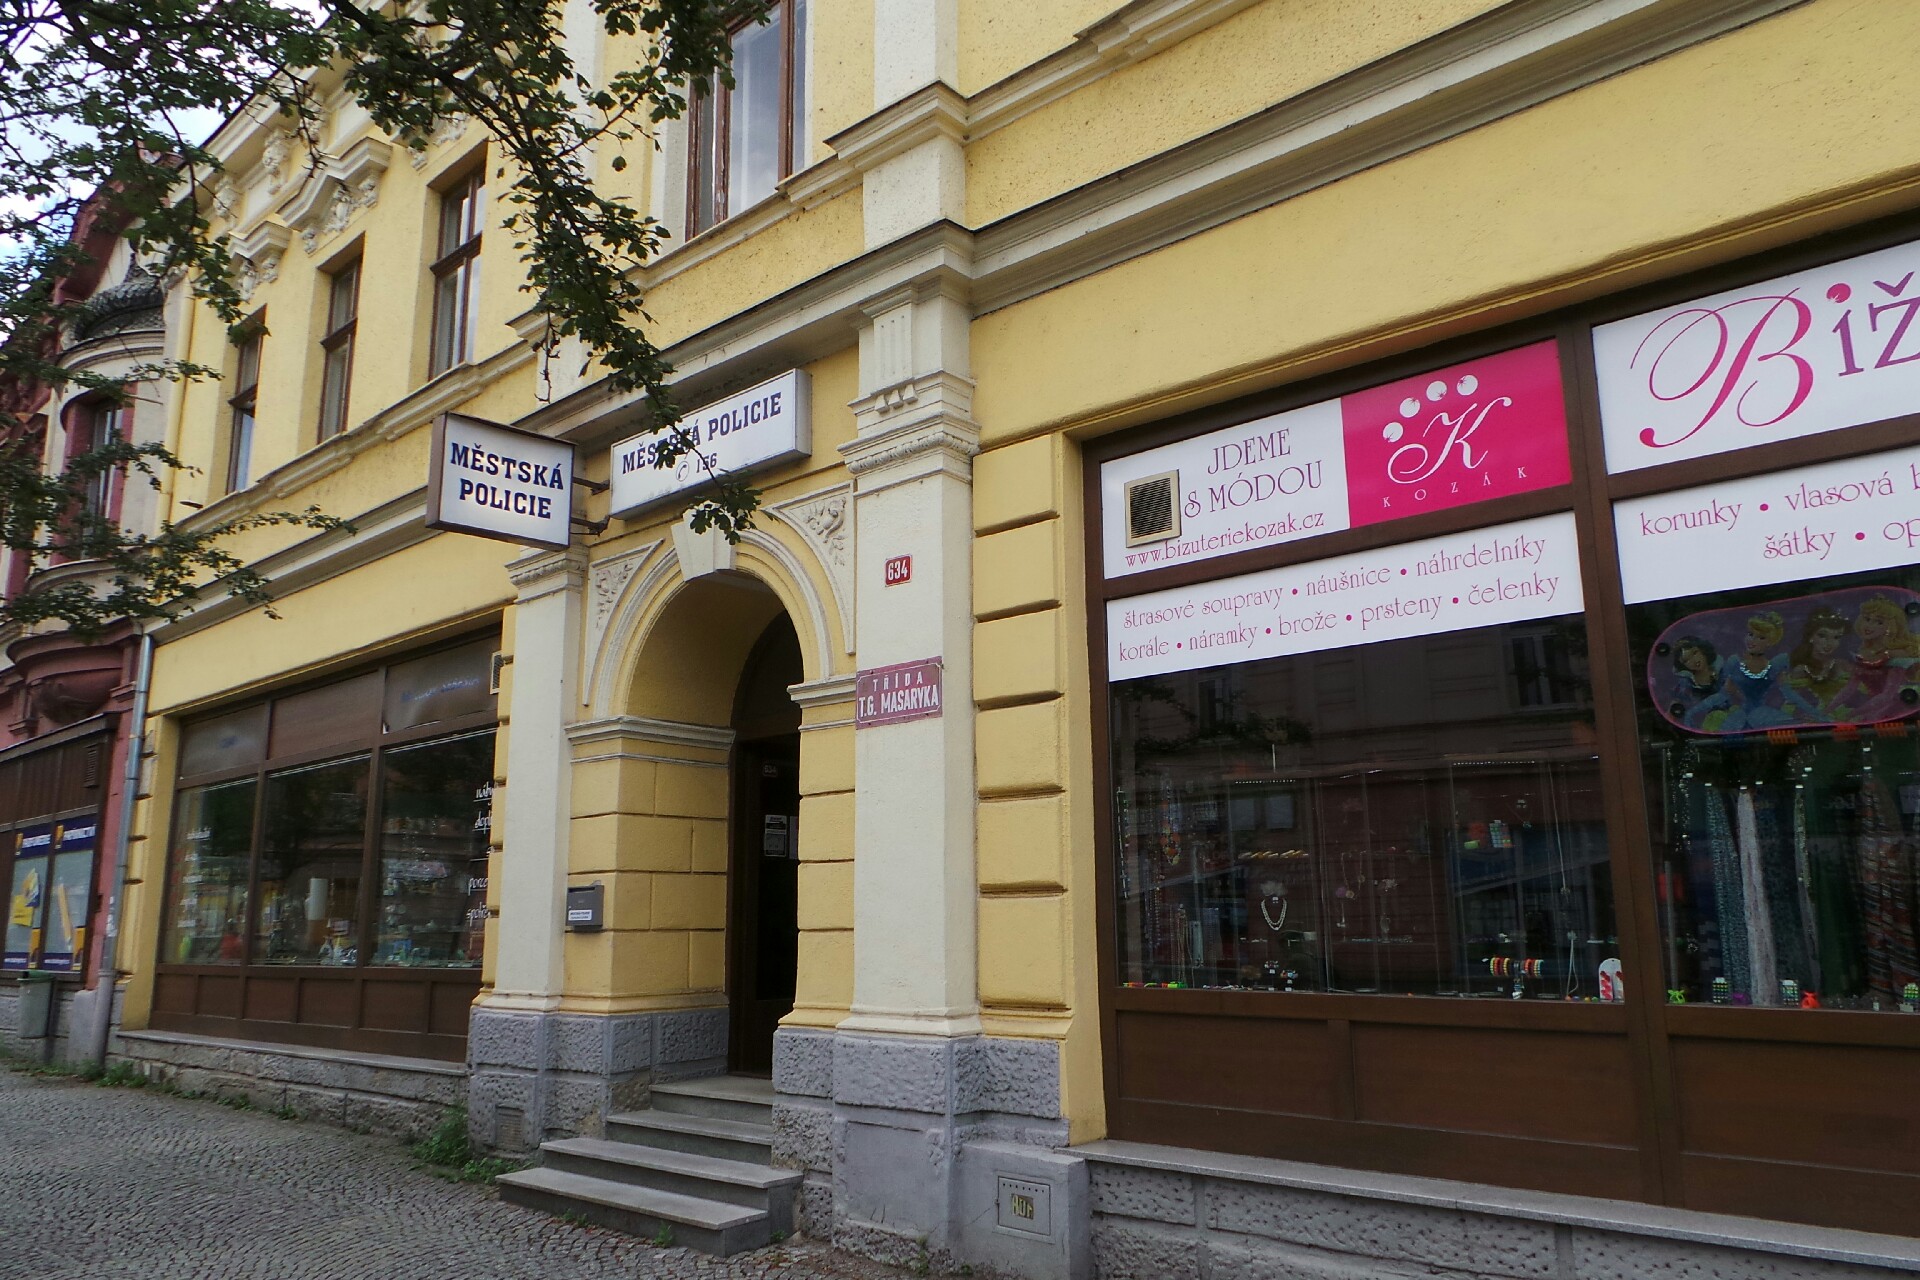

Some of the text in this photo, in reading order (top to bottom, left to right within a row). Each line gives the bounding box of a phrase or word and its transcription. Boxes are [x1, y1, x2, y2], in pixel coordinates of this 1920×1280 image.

[708, 391, 783, 441] POLICIE
[450, 442, 564, 490] MĚSTSKÁ
[696, 452, 718, 474] 156
[1208, 428, 1291, 475] JDEME
[459, 477, 552, 519] POLICIE
[1184, 460, 1322, 518] S MÓDOU
[1640, 499, 1742, 536] korunky
[1784, 471, 1894, 511] vlasová
[1125, 512, 1324, 567] www.bizuteriekozak.cz
[1763, 526, 1836, 560] šátky
[887, 560, 908, 581] 634
[1123, 535, 1546, 629] štrasové soupravy náušnice náhrdelníky
[1119, 572, 1559, 662] korále náramky brože prsteny čelenky
[858, 684, 939, 718] T.G. MASARYKA
[873, 671, 923, 692] TŘÍDA
